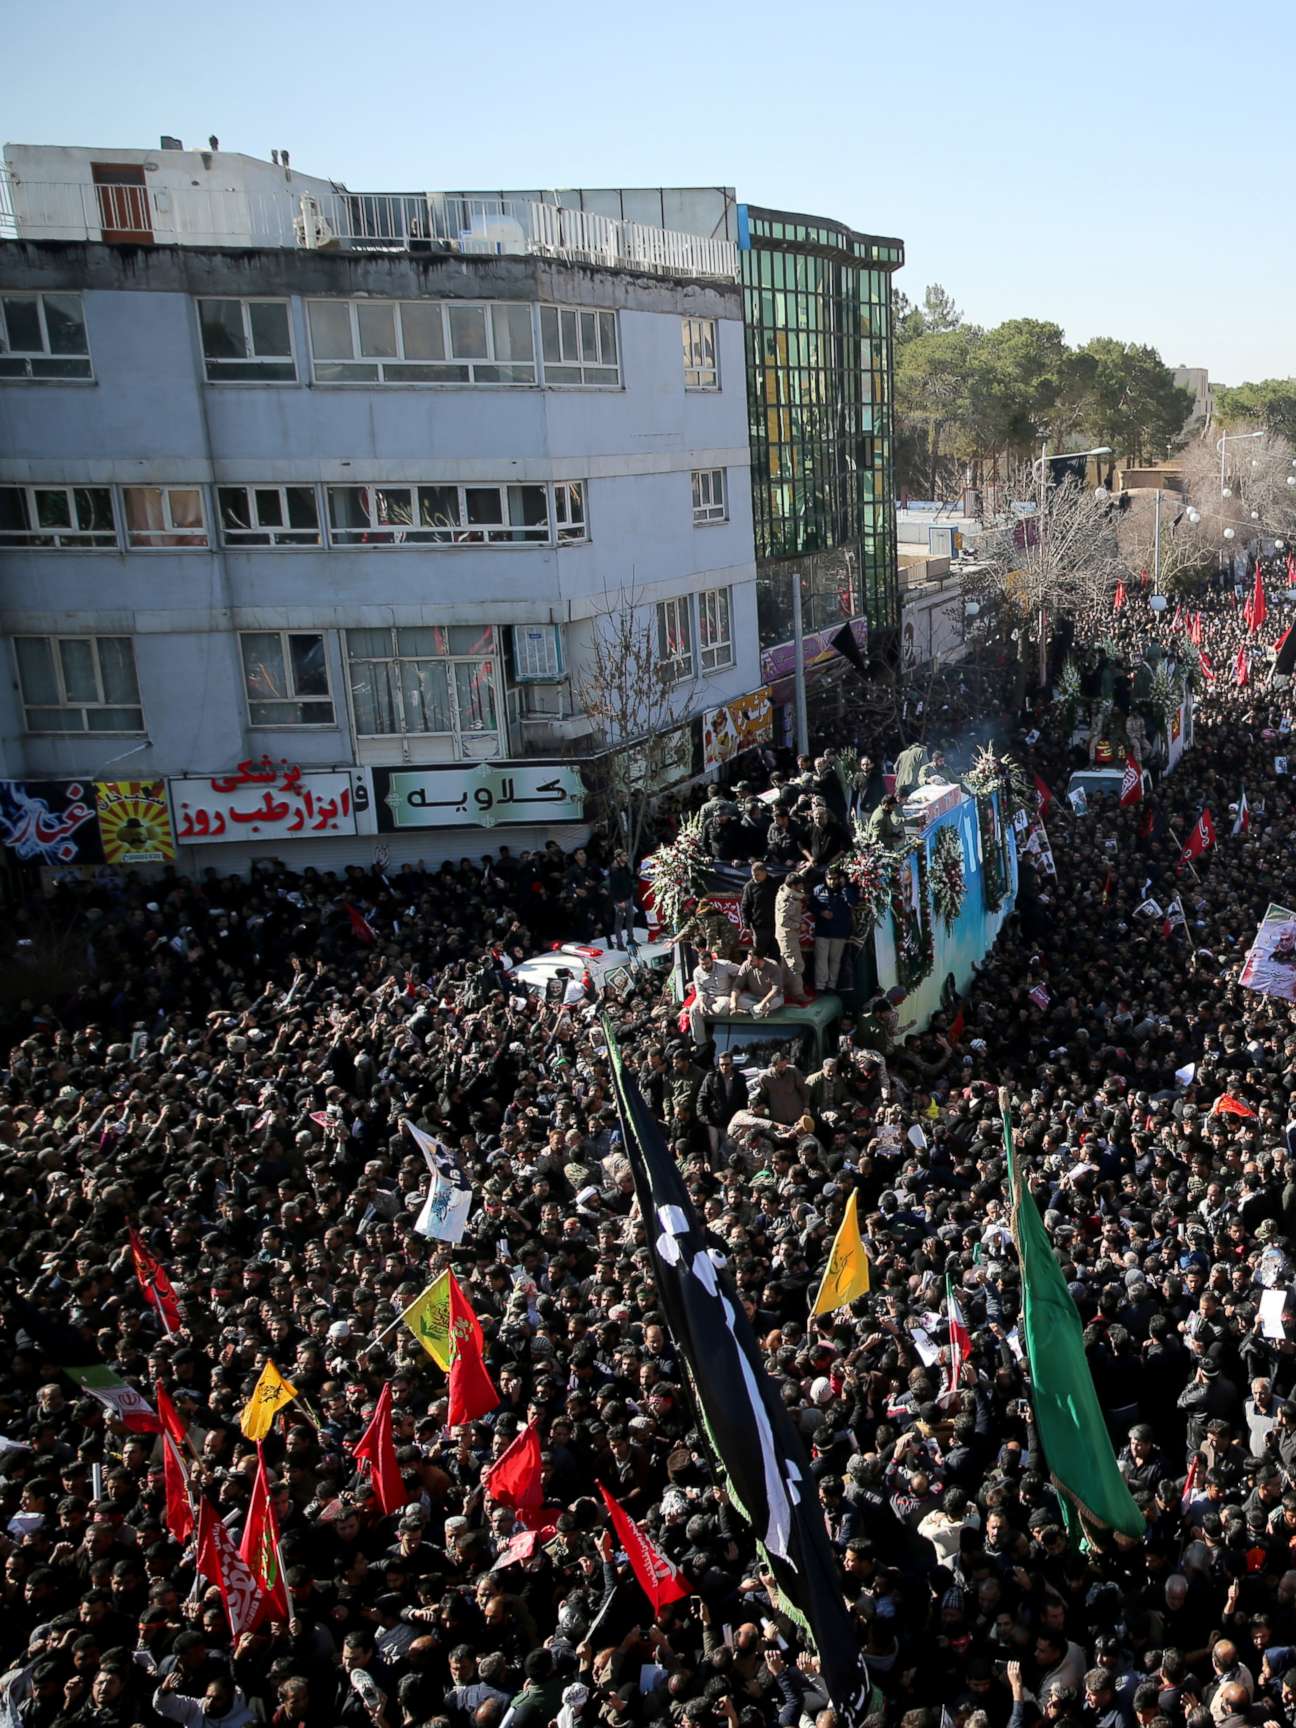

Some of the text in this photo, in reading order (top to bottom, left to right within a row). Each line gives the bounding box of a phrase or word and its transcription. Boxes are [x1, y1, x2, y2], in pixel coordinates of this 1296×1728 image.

[211, 754, 303, 796] پزشکی
[178, 788, 349, 838] ابزار طب روز
